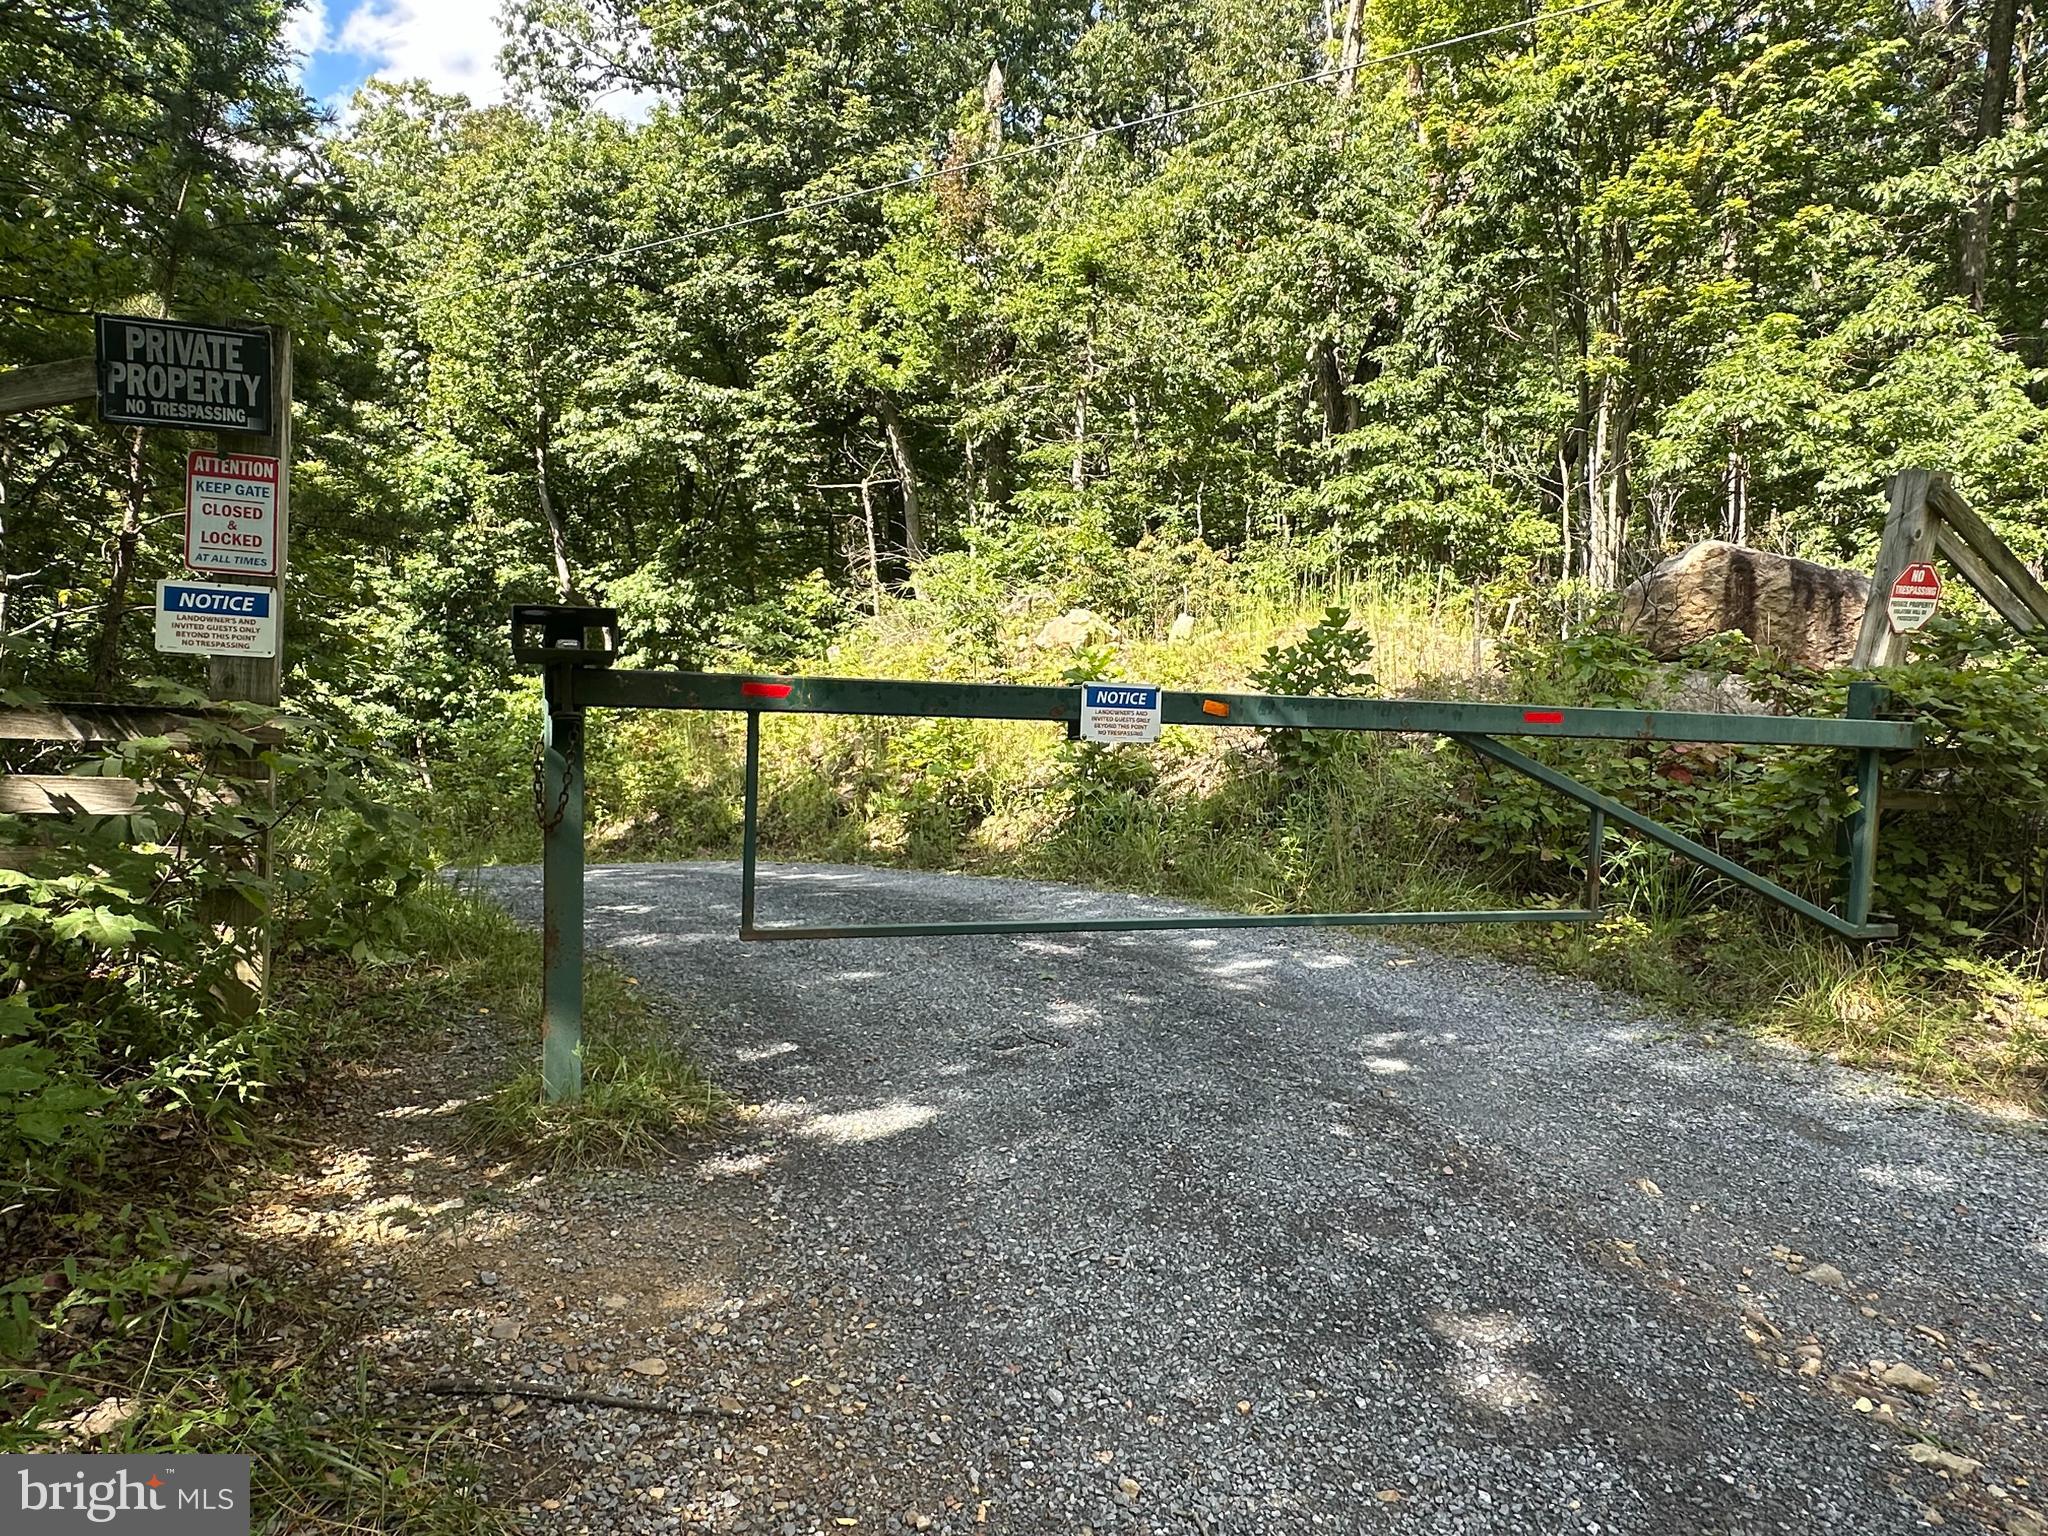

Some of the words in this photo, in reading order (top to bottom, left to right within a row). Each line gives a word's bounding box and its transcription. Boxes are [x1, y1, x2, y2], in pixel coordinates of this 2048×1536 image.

[125, 326, 244, 372] PRIVATE
[108, 361, 261, 407] PROPERTY
[126, 398, 146, 414] NO
[151, 401, 246, 423] TRESPASSING
[194, 456, 273, 478] ATTENTION
[196, 481, 231, 494] KEEP
[235, 484, 270, 498] GATE
[202, 503, 263, 520] CLOSED
[227, 520, 237, 530] &
[201, 531, 262, 547] LOCKED
[211, 554, 230, 564] ALL
[234, 556, 267, 566] TIMES
[1911, 570, 1925, 582] NO
[1896, 585, 1937, 596] TRESPASSING
[179, 592, 255, 612] NOTICE
[176, 614, 236, 624] LANDOWNER'S
[172, 622, 204, 630] INVITED
[206, 624, 238, 632] GUESTS
[239, 626, 260, 634] ONLY
[196, 640, 250, 649] TRESPASSING
[1096, 691, 1147, 705] NOTICE
